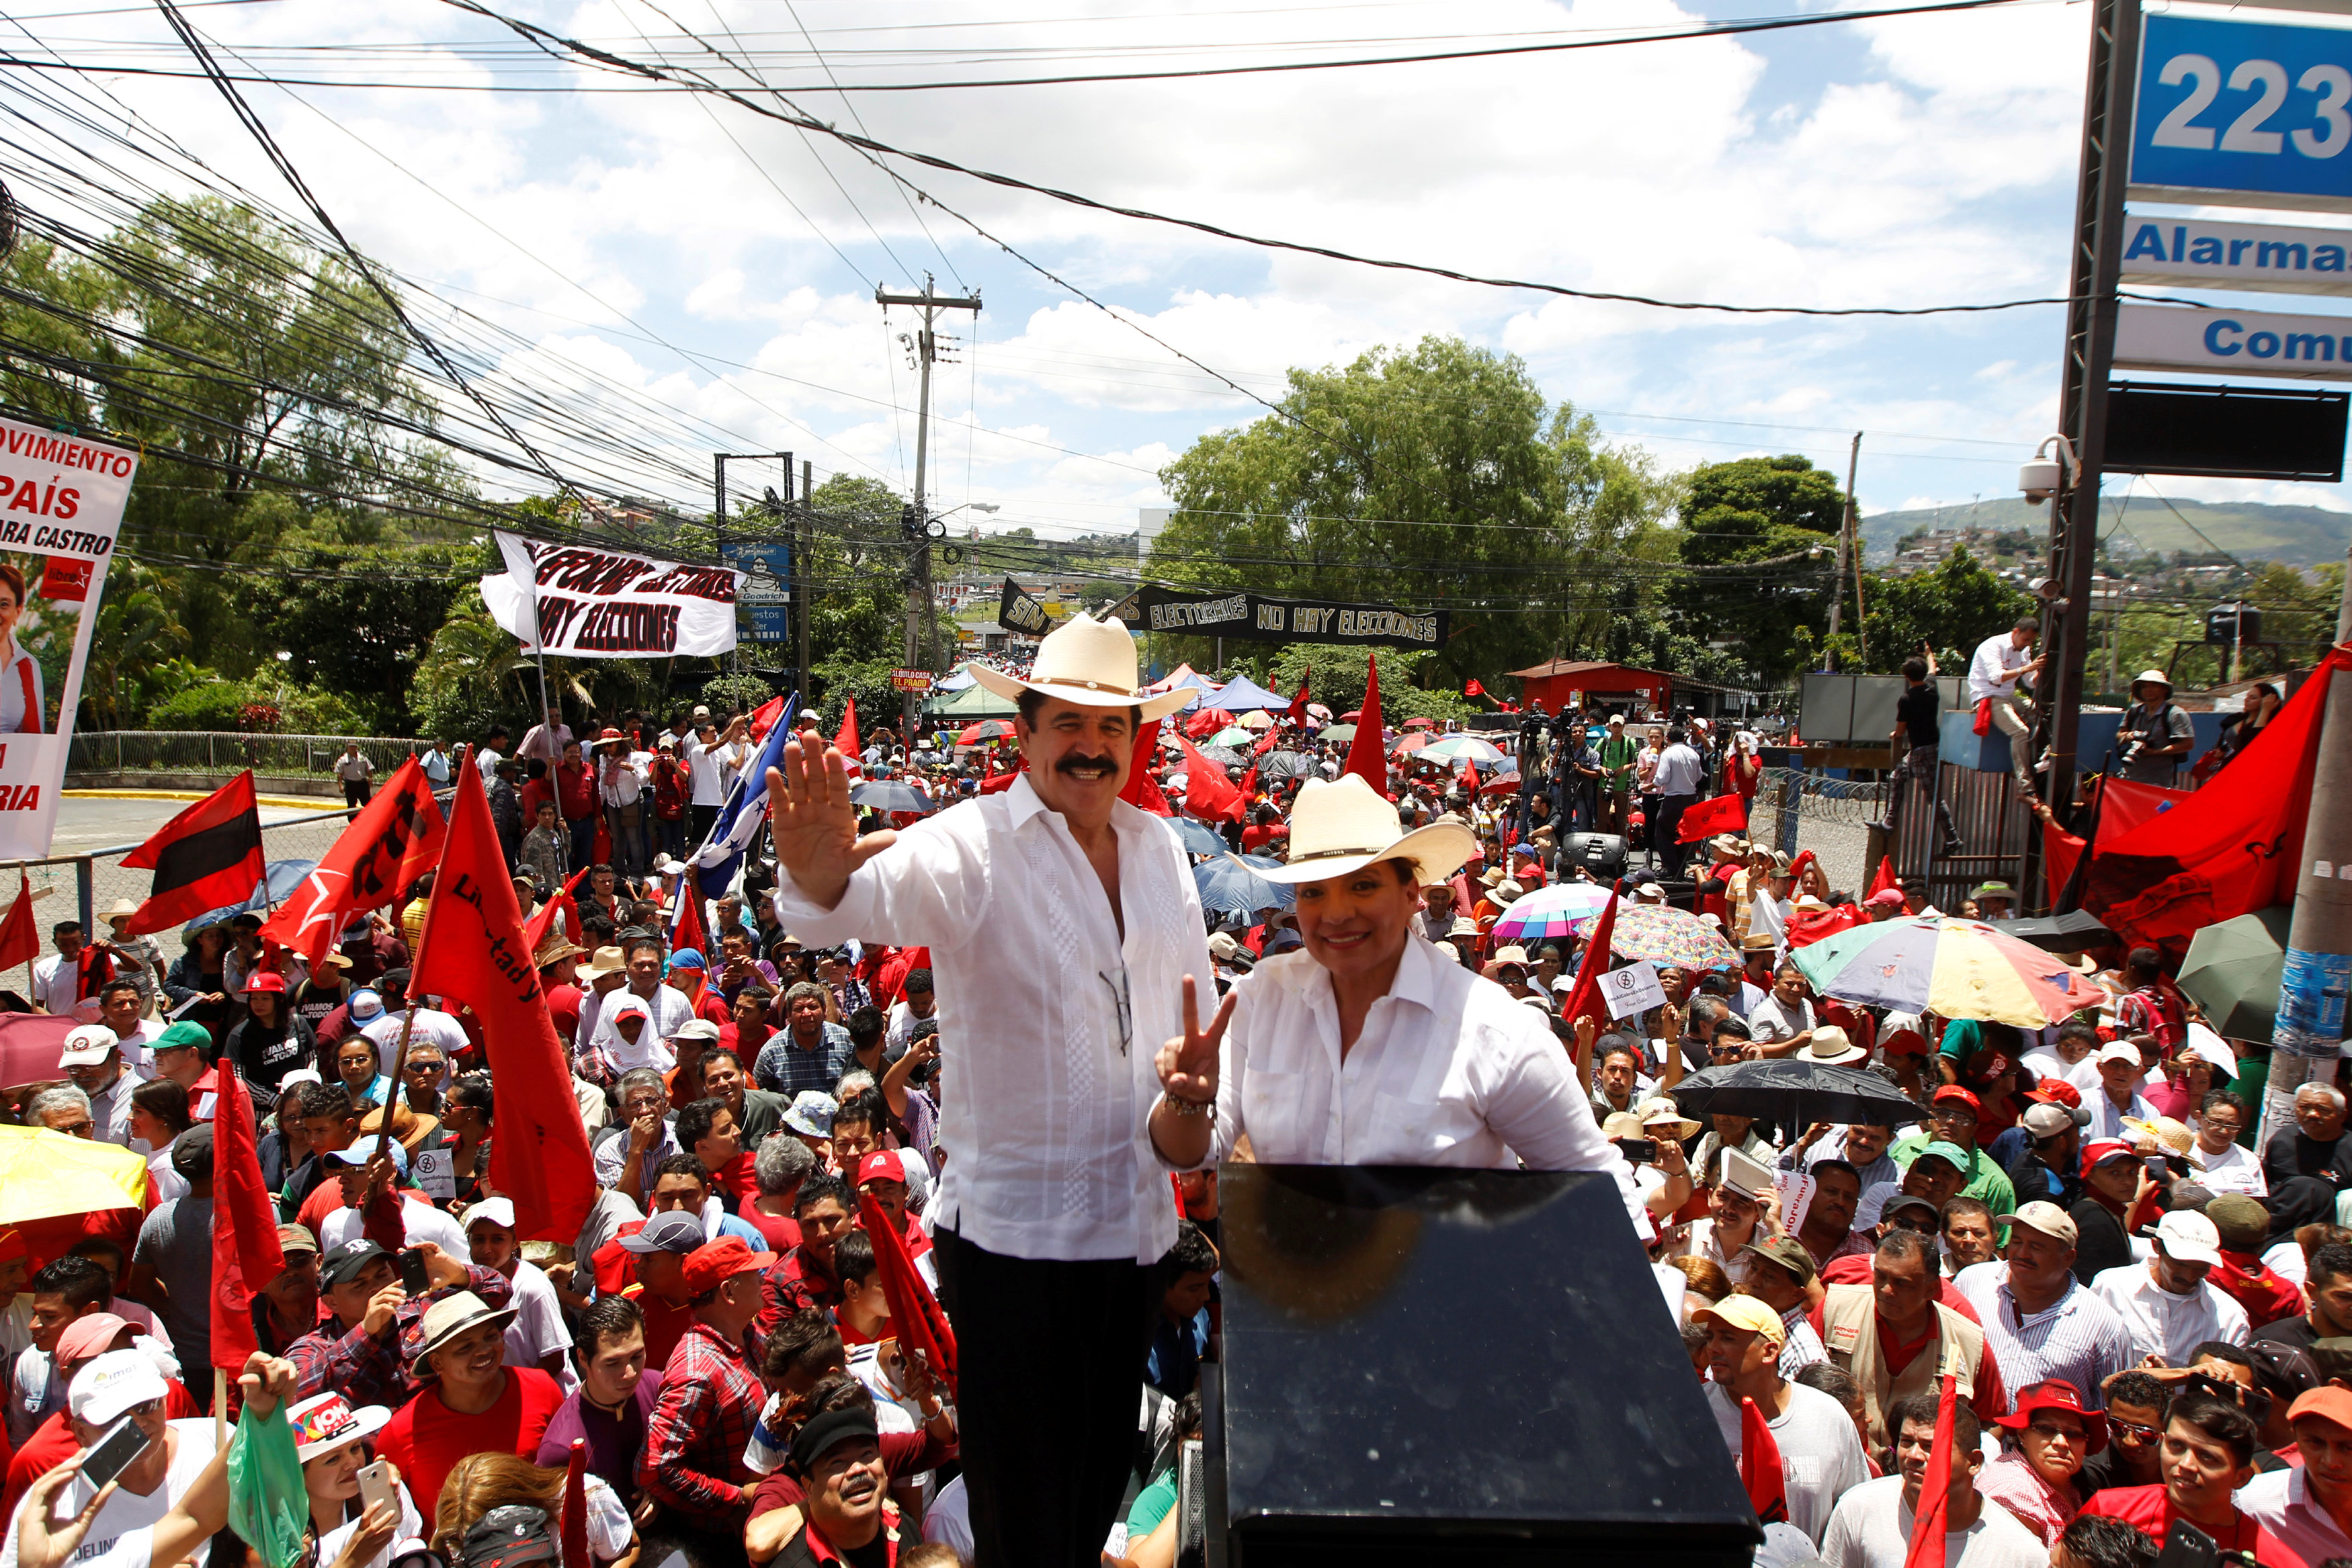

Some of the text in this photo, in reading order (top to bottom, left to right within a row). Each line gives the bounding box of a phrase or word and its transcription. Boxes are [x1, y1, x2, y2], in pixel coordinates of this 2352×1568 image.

[2124, 224, 2352, 272] Alarma
[34, 525, 112, 556] CASTRO
[574, 602, 682, 653] ELECCIONES
[1006, 595, 1047, 631] SIN
[1149, 594, 1249, 630] ELECTORALES
[1257, 603, 1285, 631] NO
[1292, 607, 1336, 634] HAY
[1337, 609, 1437, 642] ELECCIONES
[892, 670, 930, 679] ALQUILO CASA
[894, 677, 927, 687] EL PRADO
